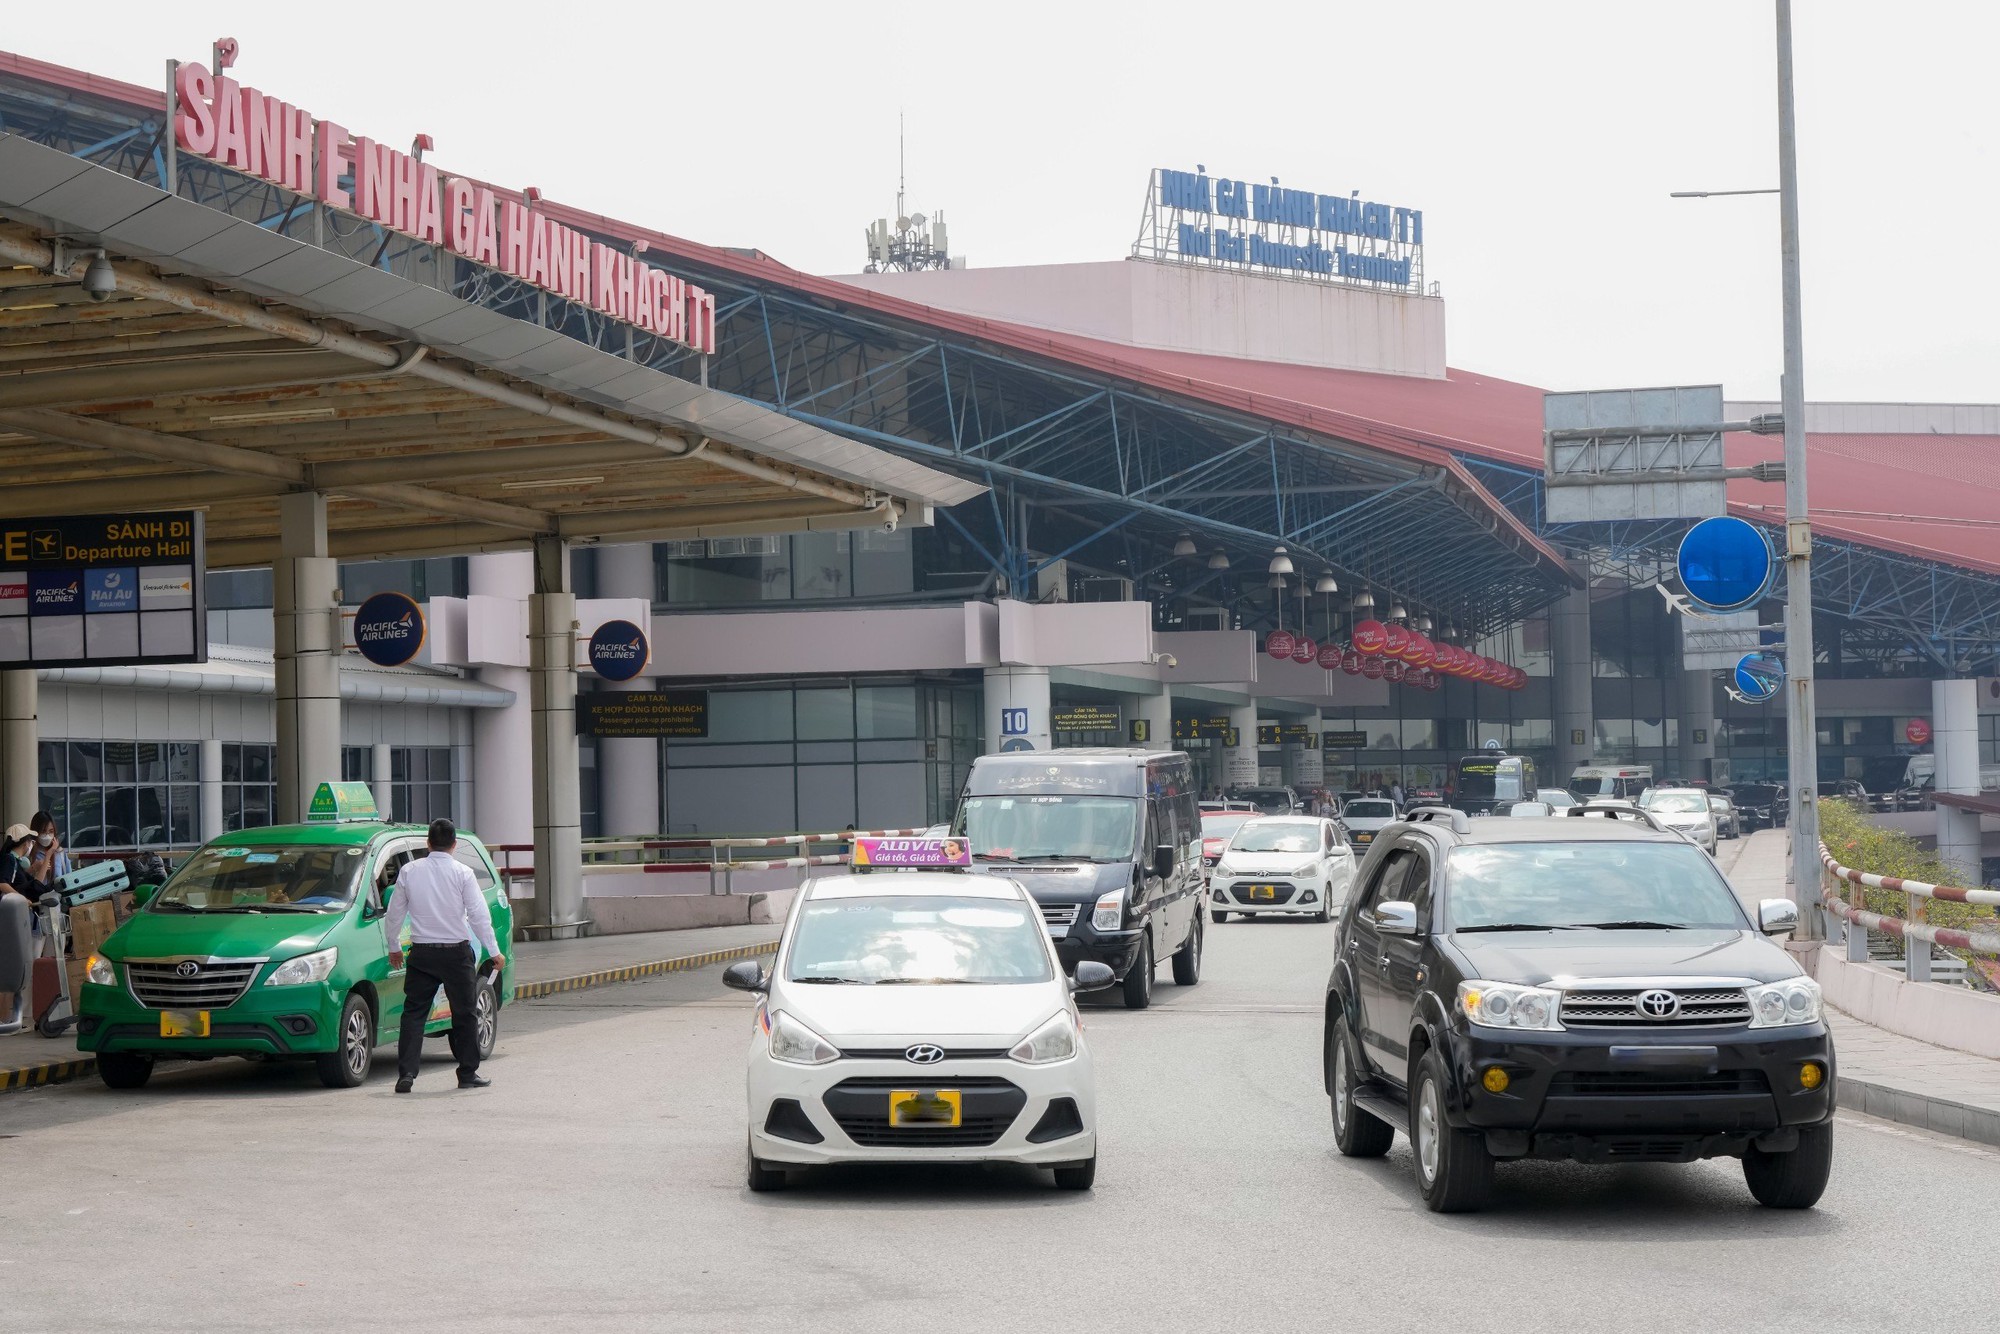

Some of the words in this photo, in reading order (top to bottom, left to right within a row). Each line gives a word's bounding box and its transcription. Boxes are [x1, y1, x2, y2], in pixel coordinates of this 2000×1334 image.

[175, 36, 312, 194] SẢNH
[319, 120, 350, 208] E
[355, 133, 442, 244] NHÀ
[445, 177, 498, 266] GA
[500, 187, 591, 304] HÀNH
[591, 240, 686, 342] KHÁCH
[686, 284, 715, 354] T1
[1161, 164, 1212, 213] NHÀ
[1216, 178, 1248, 219] GA
[1252, 176, 1315, 227] HÀNH
[1319, 190, 1391, 240] KHÁCH
[1396, 207, 1423, 244] T1
[1249, 233, 1333, 275] Domestic
[1336, 246, 1410, 285] Terminal
[107, 519, 163, 540] SẢNH
[169, 521, 190, 537] ĐI
[65, 545, 151, 562] Departure
[157, 541, 190, 556] Hall
[36, 588, 67, 596] PACIFIC
[36, 595, 74, 603] AIRLINES
[360, 621, 398, 633] PACIFIC
[362, 629, 408, 641] AIRLINES
[672, 704, 703, 713] KHÁCH
[600, 716, 634, 725] Passenger
[635, 716, 660, 724] pick-up
[661, 716, 694, 724] prohibited
[1004, 711, 1027, 732] 10
[1191, 719, 1198, 727] B
[1134, 720, 1146, 740] 9
[1696, 730, 1704, 742] 5
[1308, 733, 1316, 748] 7
[1574, 730, 1582, 744] 6
[997, 776, 1108, 785] LIMOUSINE
[875, 853, 890, 861] Giá
[892, 853, 908, 862] tốt,
[910, 853, 927, 861] Giá
[927, 853, 940, 862] tốt
